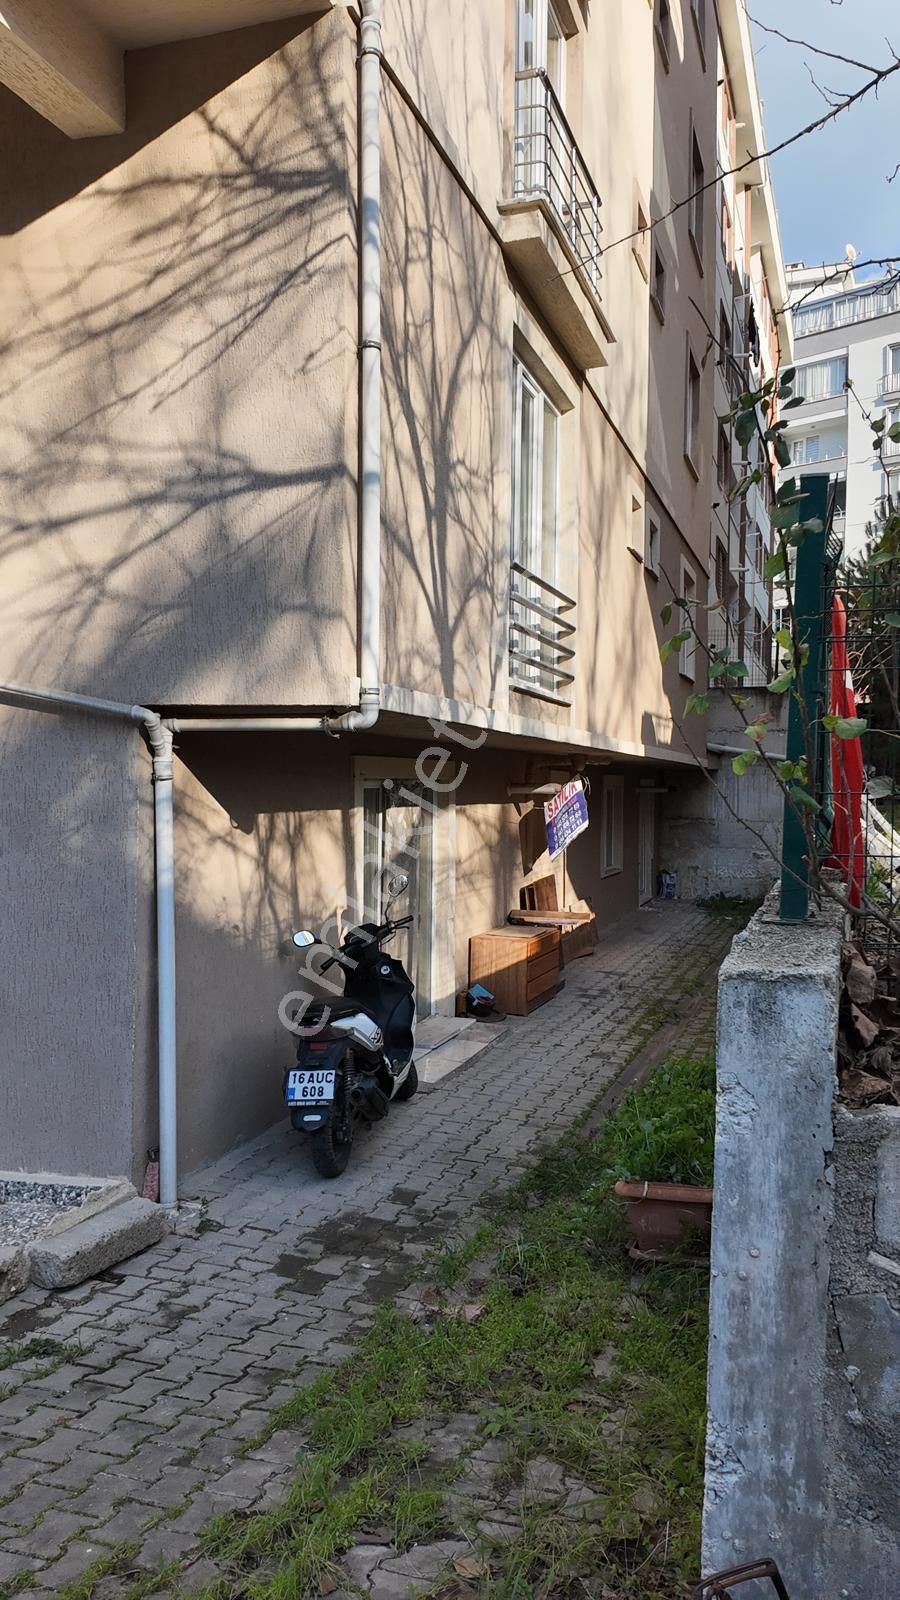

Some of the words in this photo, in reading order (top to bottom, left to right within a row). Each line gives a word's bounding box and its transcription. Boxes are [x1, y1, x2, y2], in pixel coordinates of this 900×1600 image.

[293, 1072, 305, 1084] 16
[307, 1072, 333, 1084] AUC
[302, 1086, 324, 1098] 608
